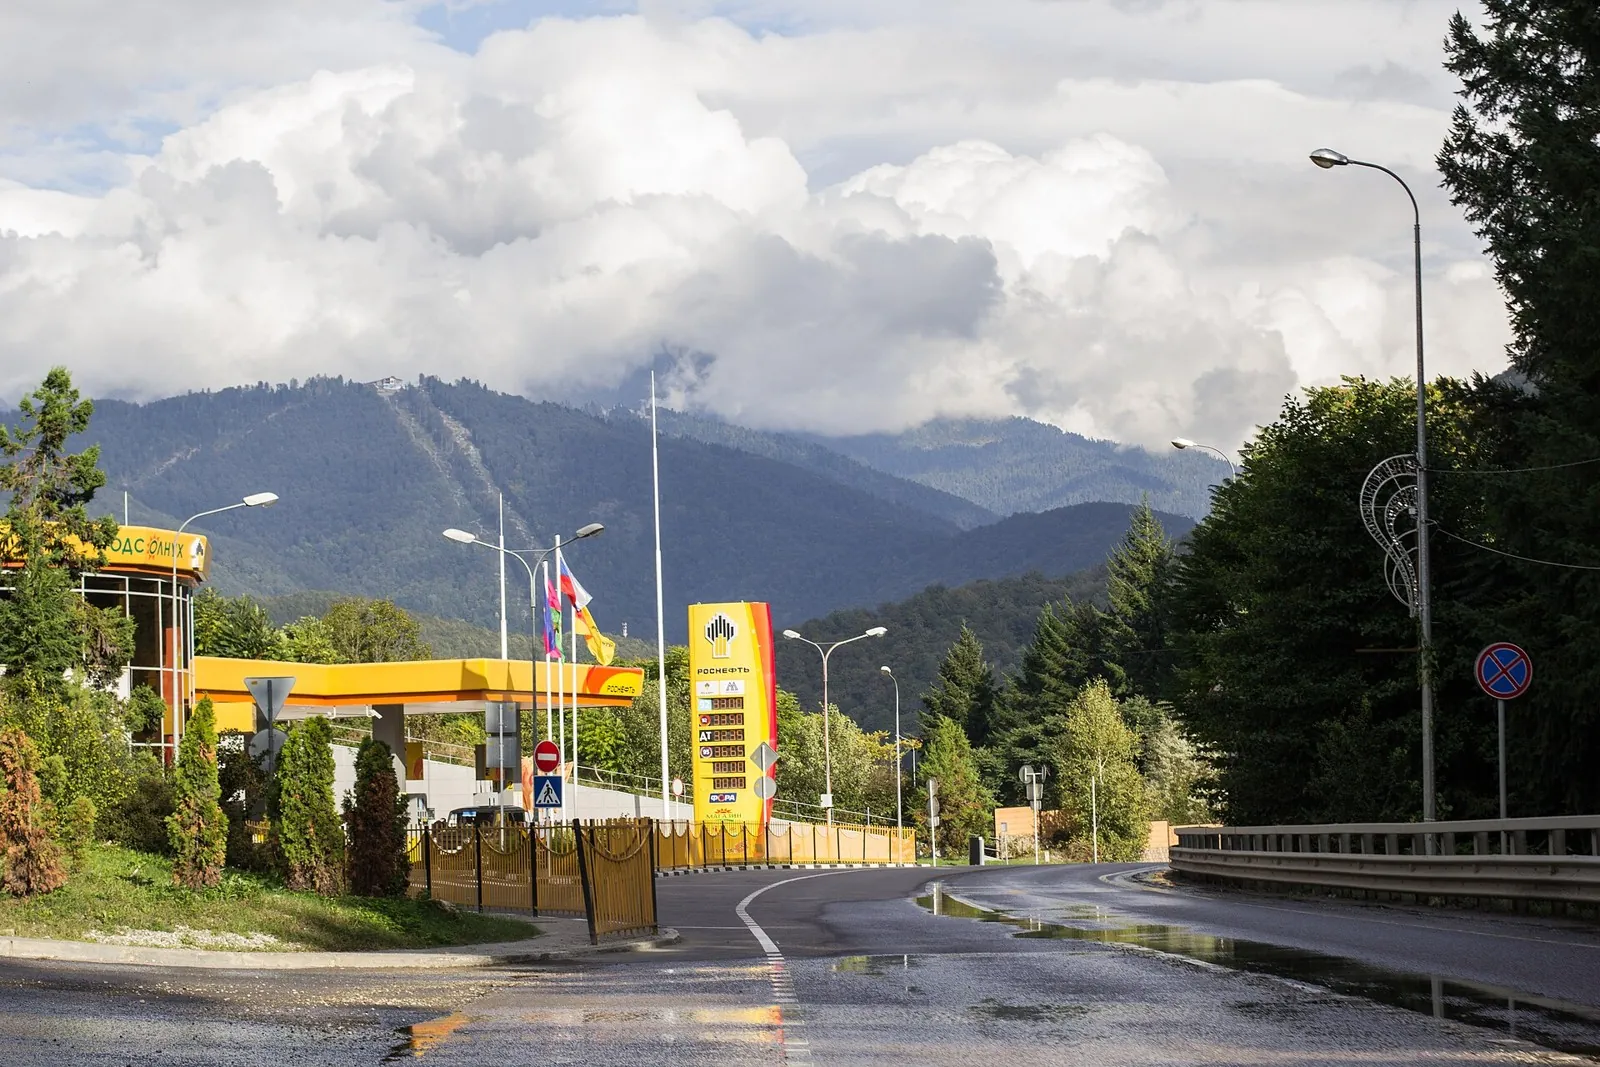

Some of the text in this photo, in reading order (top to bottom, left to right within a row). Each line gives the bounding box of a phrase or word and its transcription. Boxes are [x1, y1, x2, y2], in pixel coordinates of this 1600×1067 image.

[110, 538, 184, 558] ОДСОЛНУХ
[697, 667, 750, 675] РОСНЕФТЬ
[710, 794, 736, 802] ФОРА
